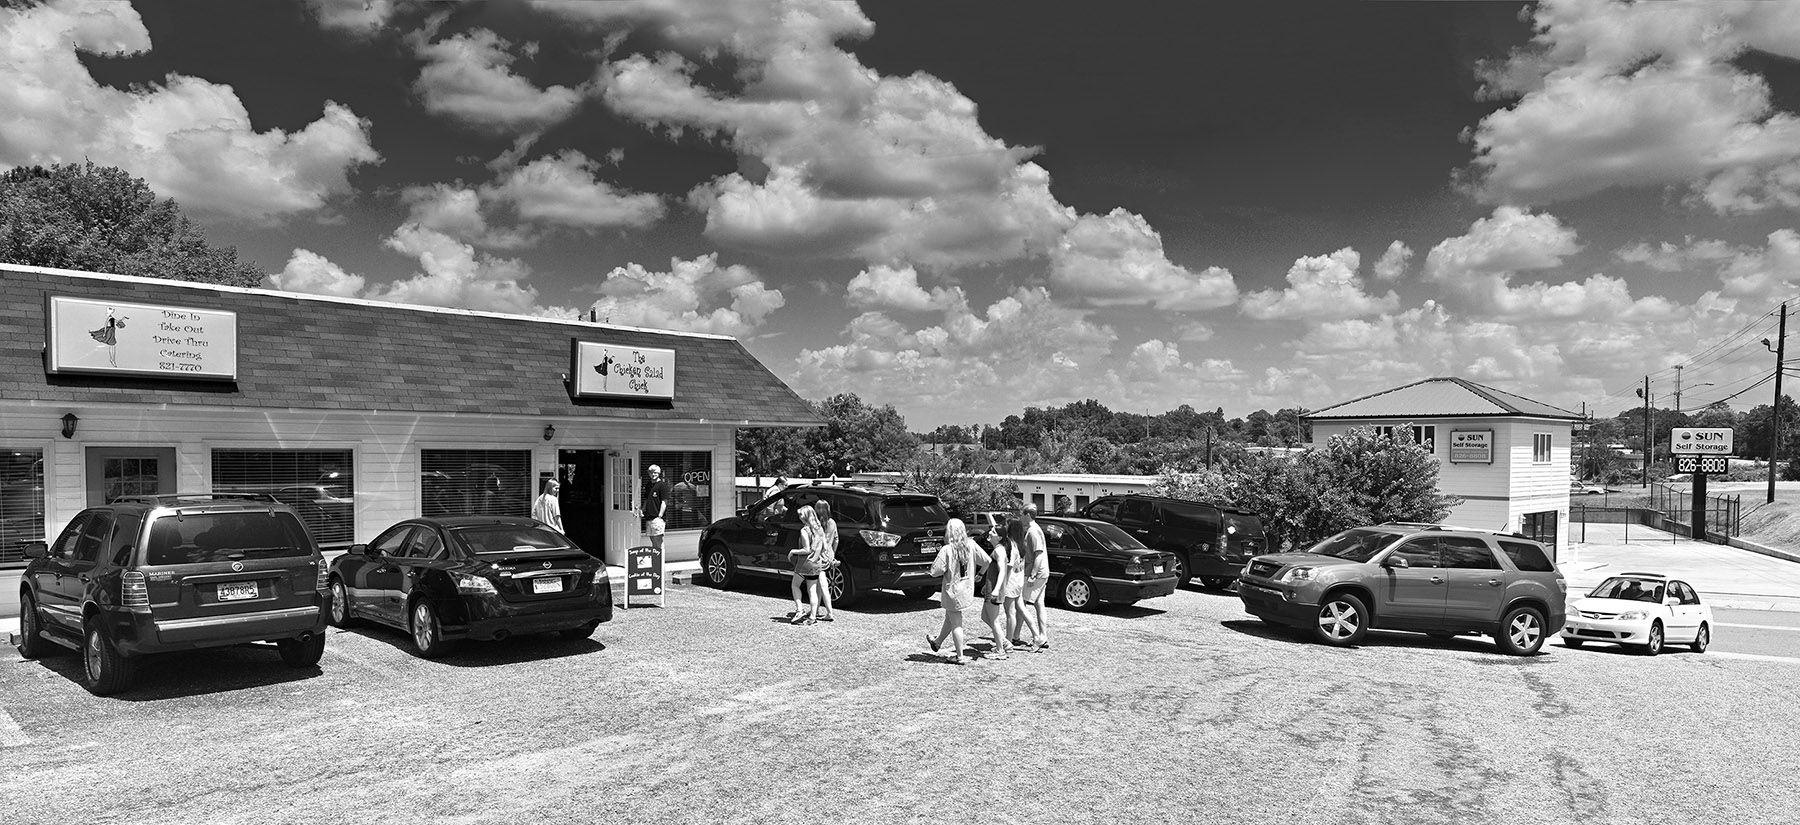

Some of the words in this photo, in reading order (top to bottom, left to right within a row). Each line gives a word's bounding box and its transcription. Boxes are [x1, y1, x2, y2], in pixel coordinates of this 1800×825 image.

[161, 310, 187, 320] Dine
[190, 313, 201, 321] In
[158, 322, 181, 332] Take
[184, 325, 204, 334] Out
[152, 335, 182, 345] Drive
[184, 337, 209, 347] Thru
[159, 349, 203, 361] Catering
[632, 351, 646, 364] The
[159, 361, 202, 372] 821-7770
[613, 363, 642, 378] Chicken
[643, 366, 664, 380] Salad
[628, 379, 649, 394] Chick
[1694, 432, 1724, 441] SUN
[1695, 443, 1729, 452] Storage
[1678, 458, 1726, 472] 826-8808
[684, 471, 710, 483] OPEN
